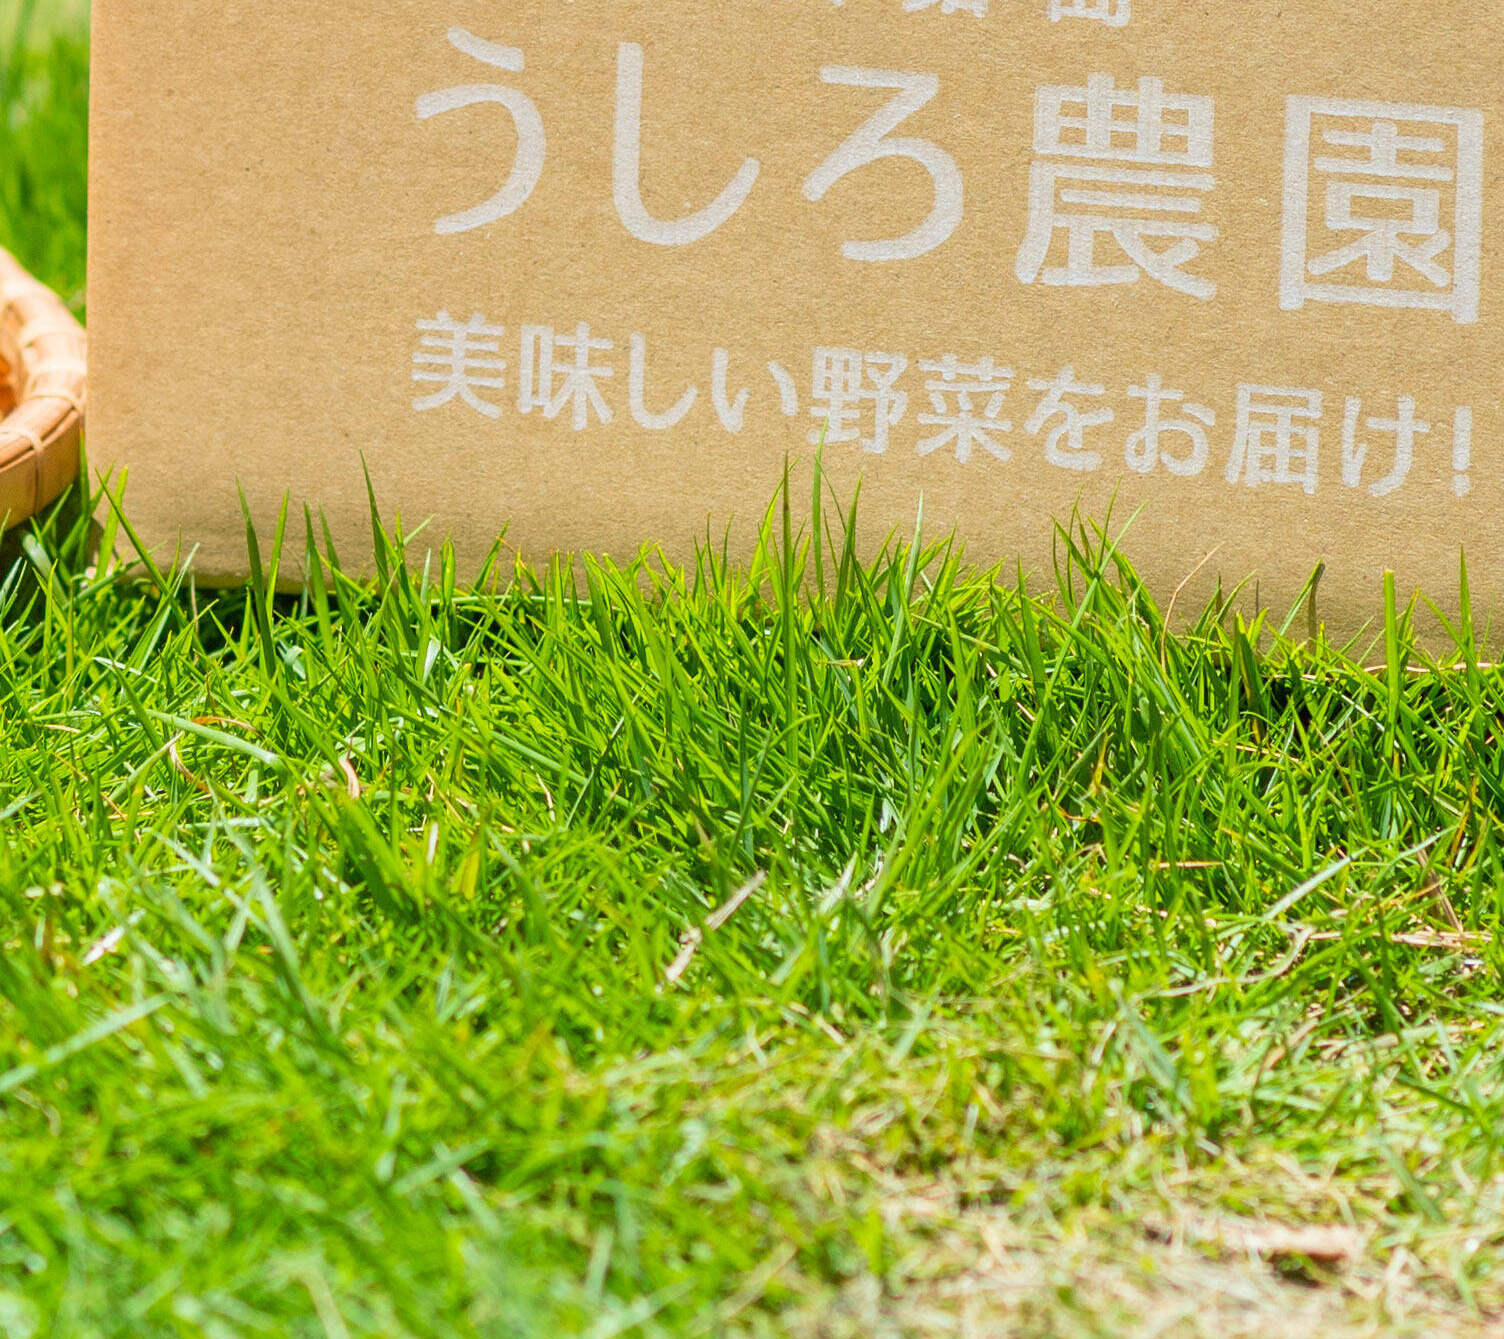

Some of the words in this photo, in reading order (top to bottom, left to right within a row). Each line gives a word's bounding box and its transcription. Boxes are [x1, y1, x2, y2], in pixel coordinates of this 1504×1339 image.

[414, 25, 1485, 325] うしろ農園
[410, 310, 1473, 498] 美味しい野菜をお届け!
